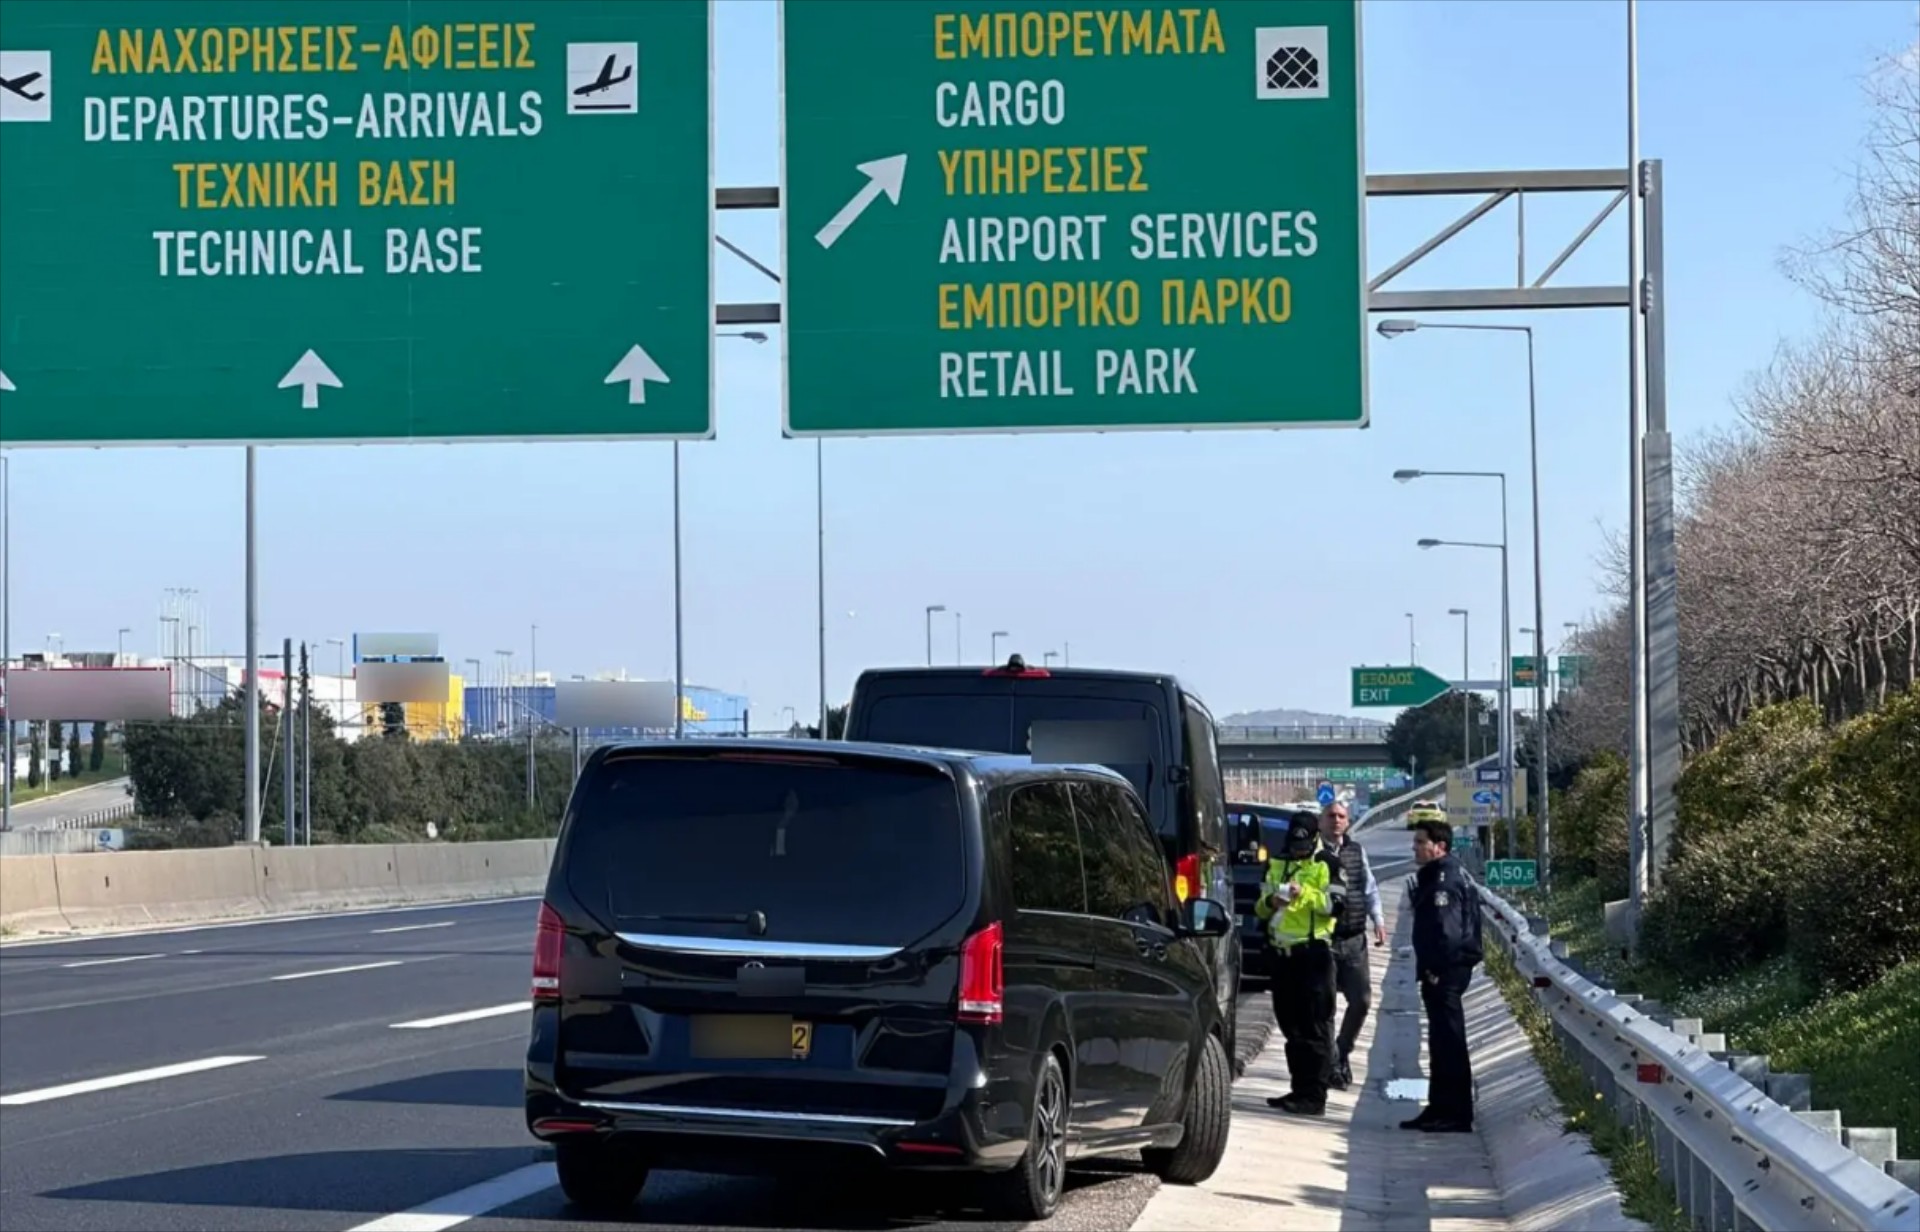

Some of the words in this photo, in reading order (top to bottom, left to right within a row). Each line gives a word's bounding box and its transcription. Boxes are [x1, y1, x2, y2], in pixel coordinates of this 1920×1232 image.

[92, 23, 535, 74] ΑΝΑΧΩΡΗΣΕΙΣ-ΑΦΙΞΕΙΣ
[935, 8, 1226, 59] ΕΜΠΟΡΕΥΜΑΤΑ
[84, 91, 542, 141] DEPARTURES-ARRIVALS
[936, 80, 1065, 127] CARGO
[173, 162, 337, 208] ΤΕΧΝΙΚΗ
[359, 160, 455, 205] ΒΑΣΗ
[938, 147, 1148, 195] ΥΠΗΡΕΣΙΕΣ
[153, 229, 363, 276] TECHNICAL
[386, 227, 482, 273] BASE
[939, 215, 1106, 263] AIRPORT
[1130, 211, 1318, 258] SERVICES
[938, 280, 1139, 329] ΕΜΠΟΡΙΚΟ
[1161, 277, 1291, 324] ΠΑΡΚΟ
[940, 350, 1073, 397] RETAIL
[1097, 348, 1198, 394] PARK
[1359, 671, 1415, 686] ΕΞΟΔΟΣ
[1359, 688, 1391, 702] EXIT
